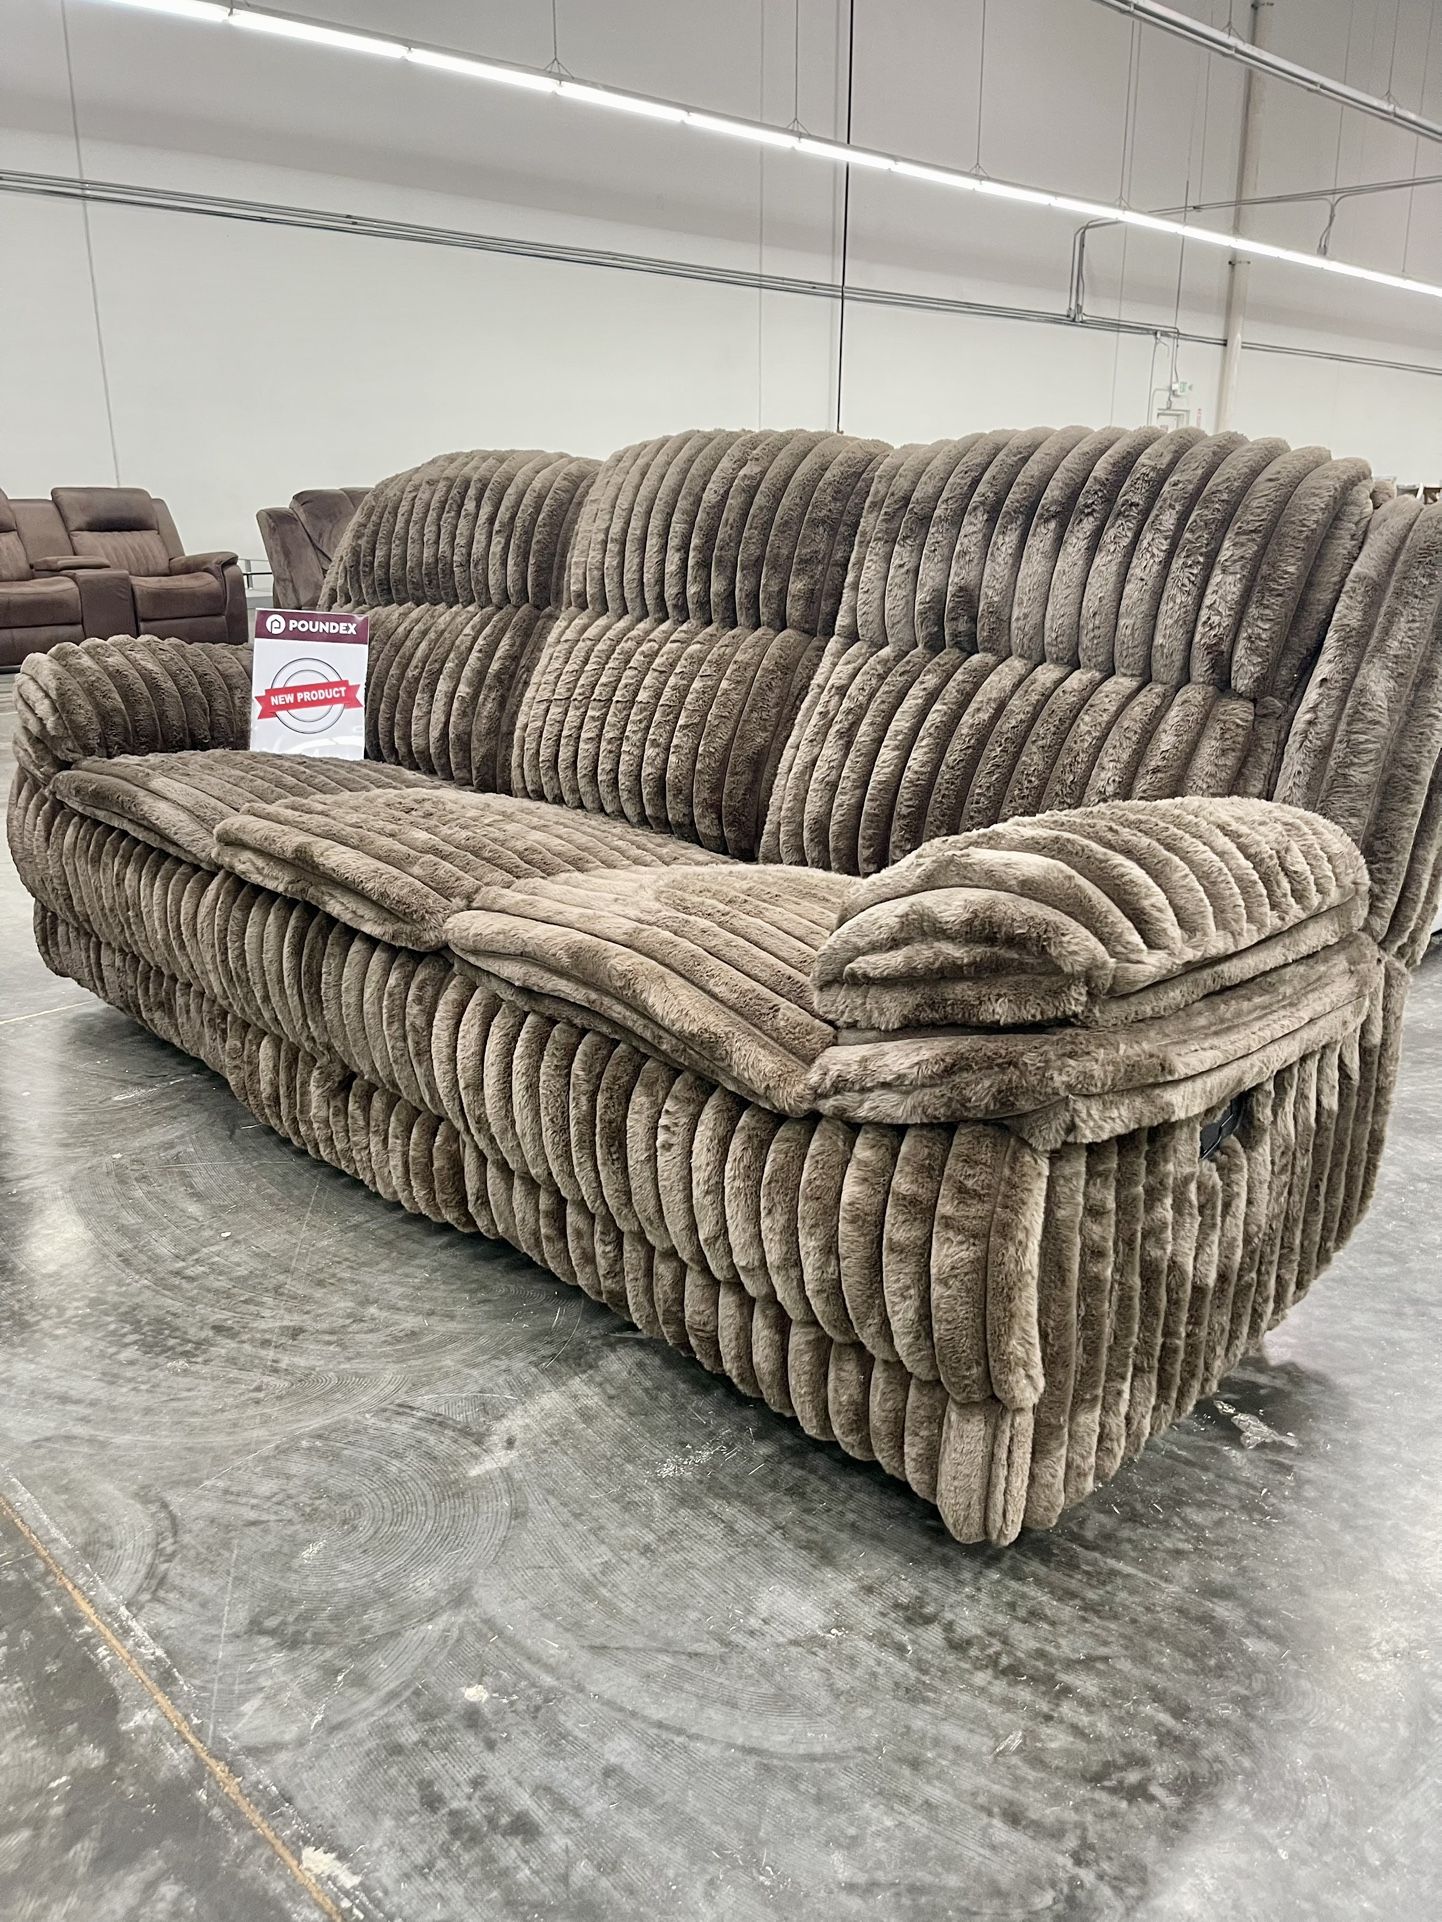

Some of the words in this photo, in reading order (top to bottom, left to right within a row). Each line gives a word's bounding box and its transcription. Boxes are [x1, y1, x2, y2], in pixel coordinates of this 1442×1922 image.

[289, 620, 357, 635] POUNDEX
[271, 693, 294, 706] NEW
[297, 687, 347, 702] PRODUCT
